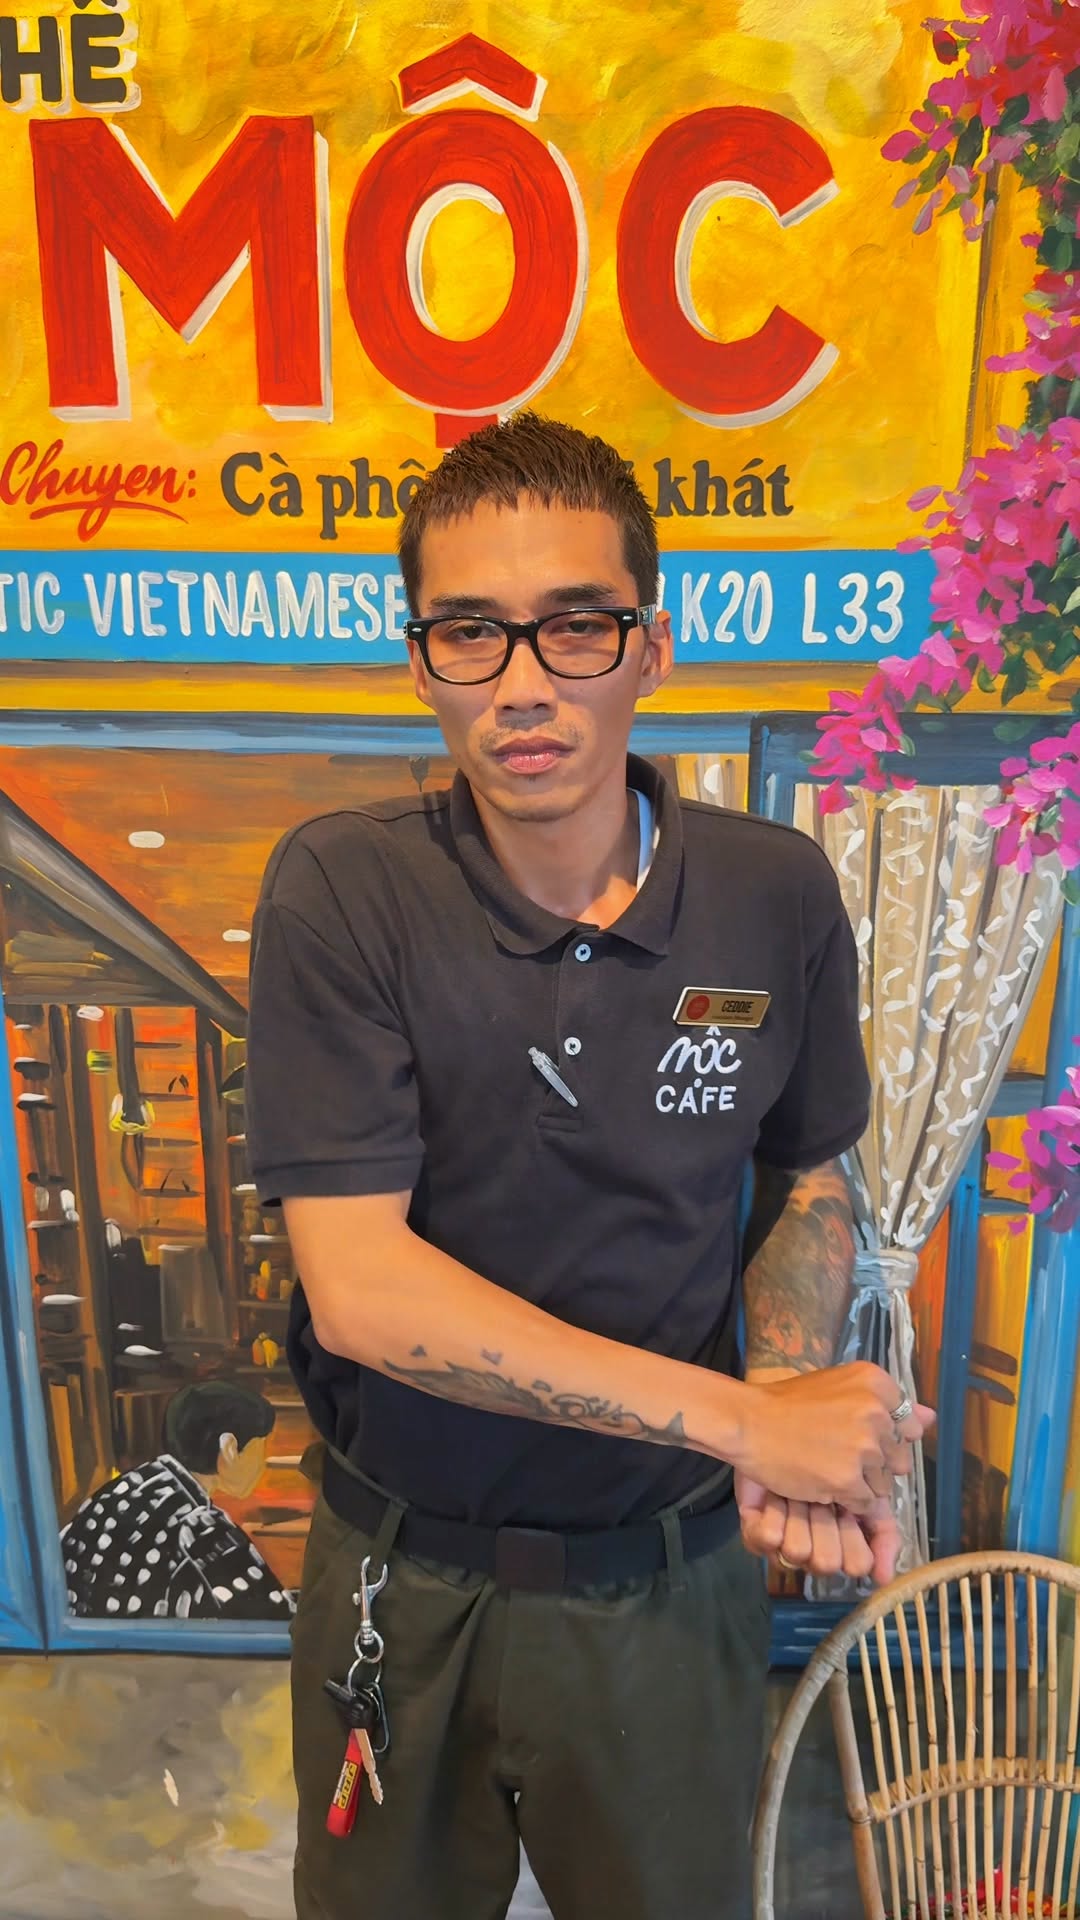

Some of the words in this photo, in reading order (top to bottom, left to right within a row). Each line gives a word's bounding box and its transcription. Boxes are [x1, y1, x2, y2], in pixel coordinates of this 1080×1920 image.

[221, 452, 303, 517] Cà
[653, 457, 795, 518] khát
[83, 569, 407, 642] VIETNAMESE
[680, 570, 774, 645] K20
[801, 570, 905, 645] L33
[655, 1085, 737, 1114] CAFE
